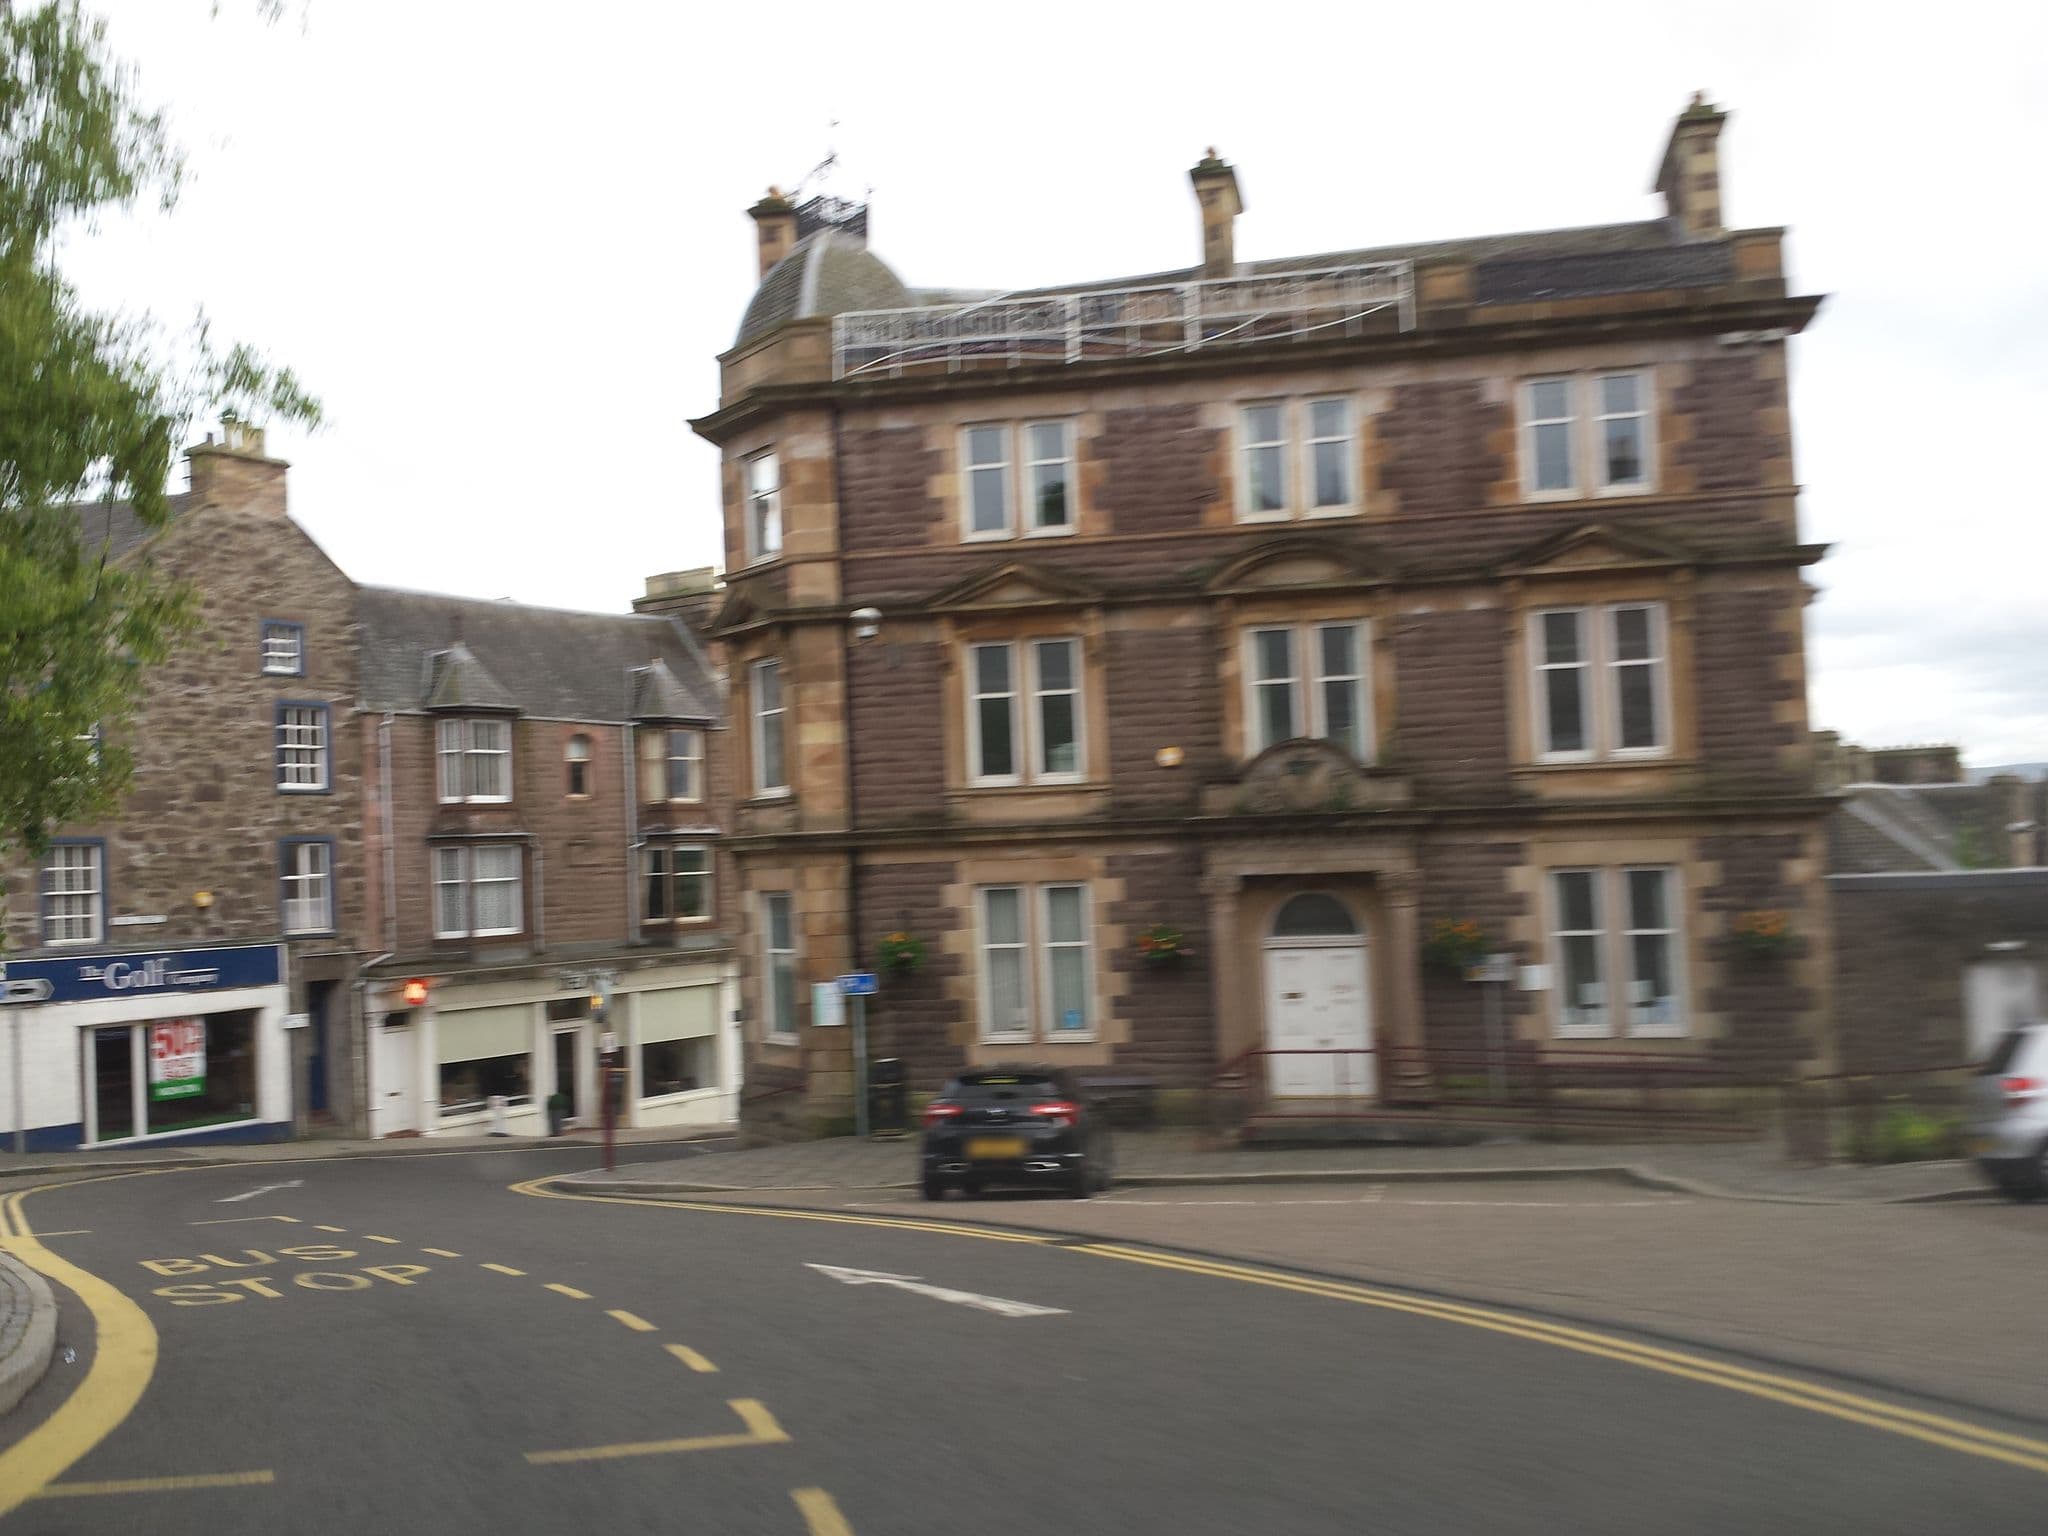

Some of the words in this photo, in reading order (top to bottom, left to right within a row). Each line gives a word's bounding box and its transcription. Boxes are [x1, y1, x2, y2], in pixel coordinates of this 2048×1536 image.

[104, 957, 171, 989] Golf
[137, 1245, 359, 1276] BUS
[152, 1264, 431, 1306] STOP
